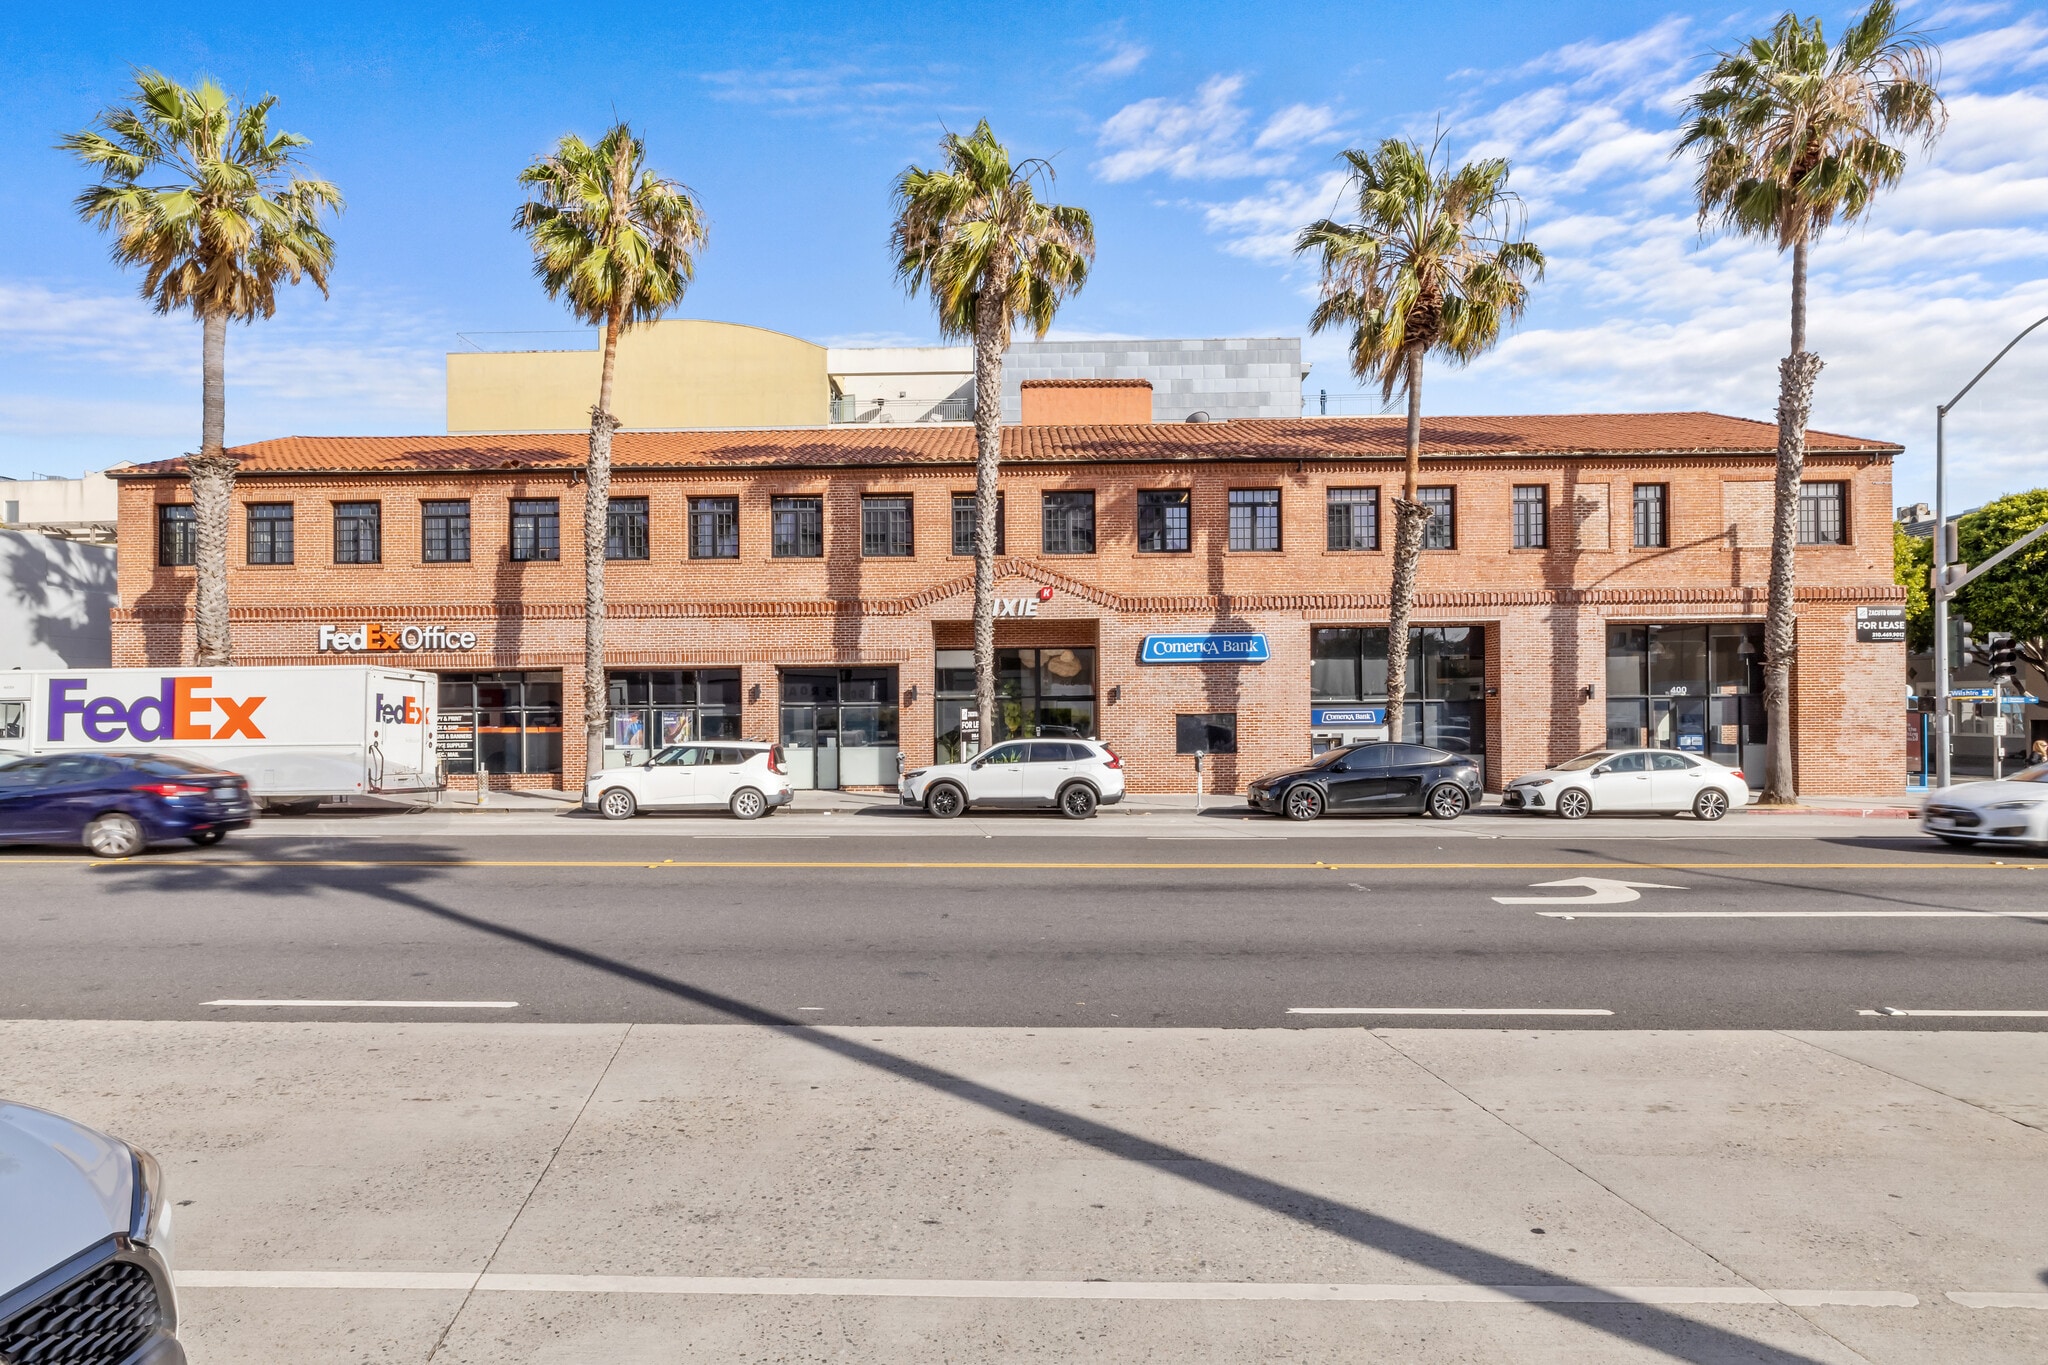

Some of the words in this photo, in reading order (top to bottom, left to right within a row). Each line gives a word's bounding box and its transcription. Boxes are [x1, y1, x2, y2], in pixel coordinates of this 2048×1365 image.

[1043, 588, 1051, 597] K
[992, 597, 1040, 617] IXIE
[1857, 621, 1877, 630] FOR
[1878, 621, 1905, 630] LEASE
[319, 624, 400, 650] FedEx
[401, 625, 477, 650] Office
[1223, 639, 1259, 653] Bank
[47, 676, 267, 743] FedEx
[375, 693, 430, 725] FedEx
[961, 721, 973, 729] FOR
